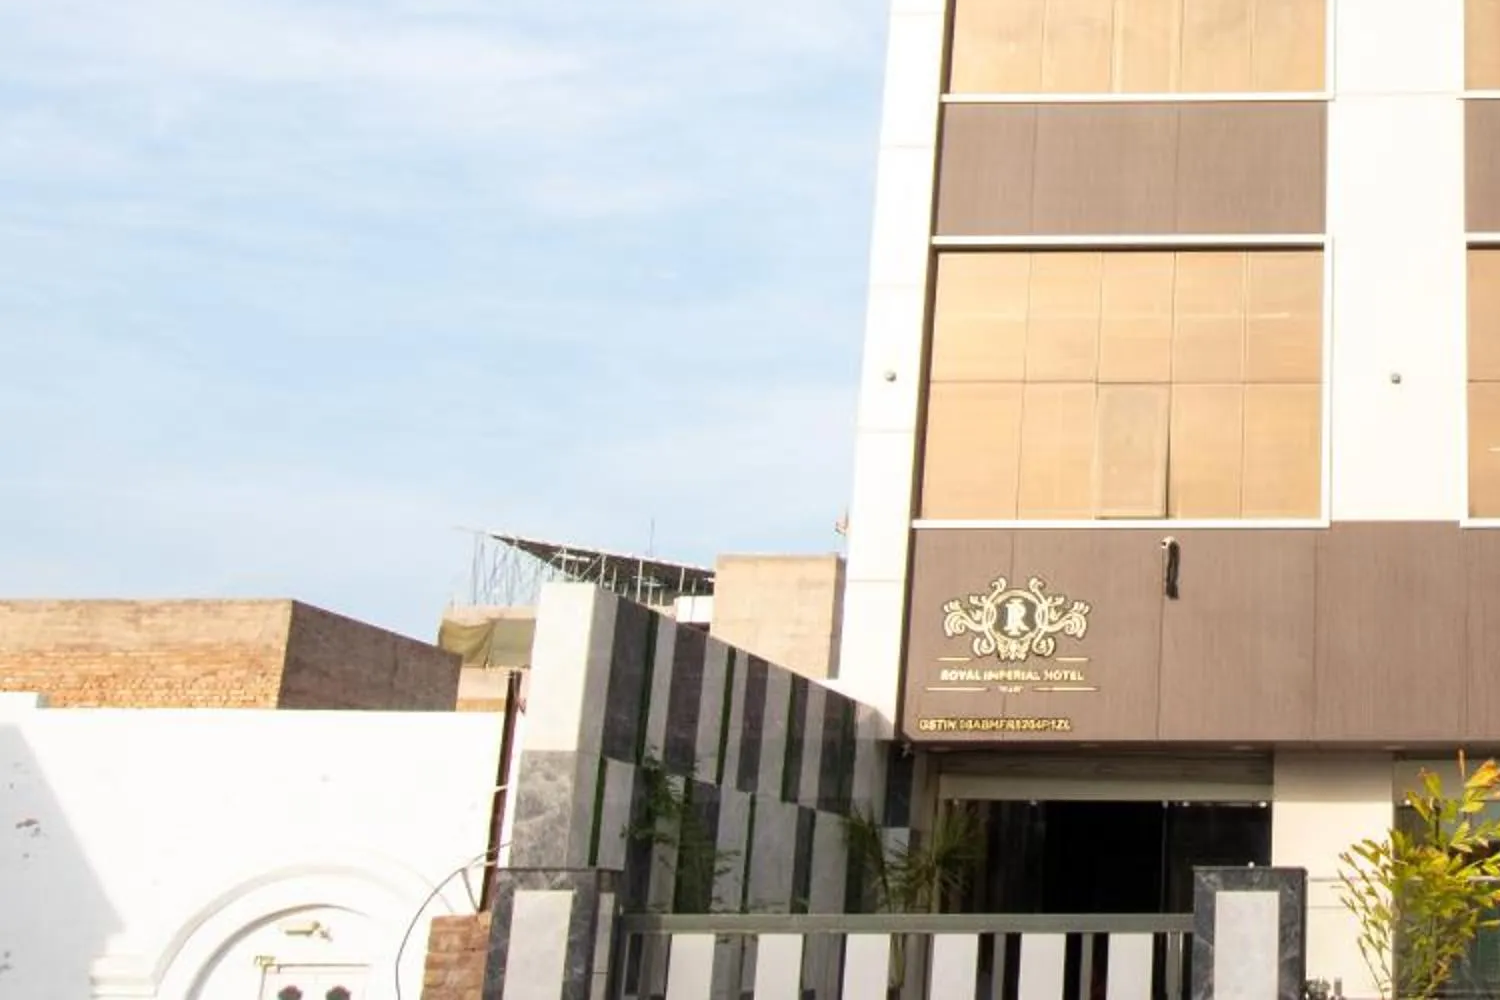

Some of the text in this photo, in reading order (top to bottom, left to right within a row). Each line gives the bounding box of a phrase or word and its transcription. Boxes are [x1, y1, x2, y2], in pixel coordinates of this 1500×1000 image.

[940, 669, 1085, 681] ROYAL IMPERIAL HOTEL
